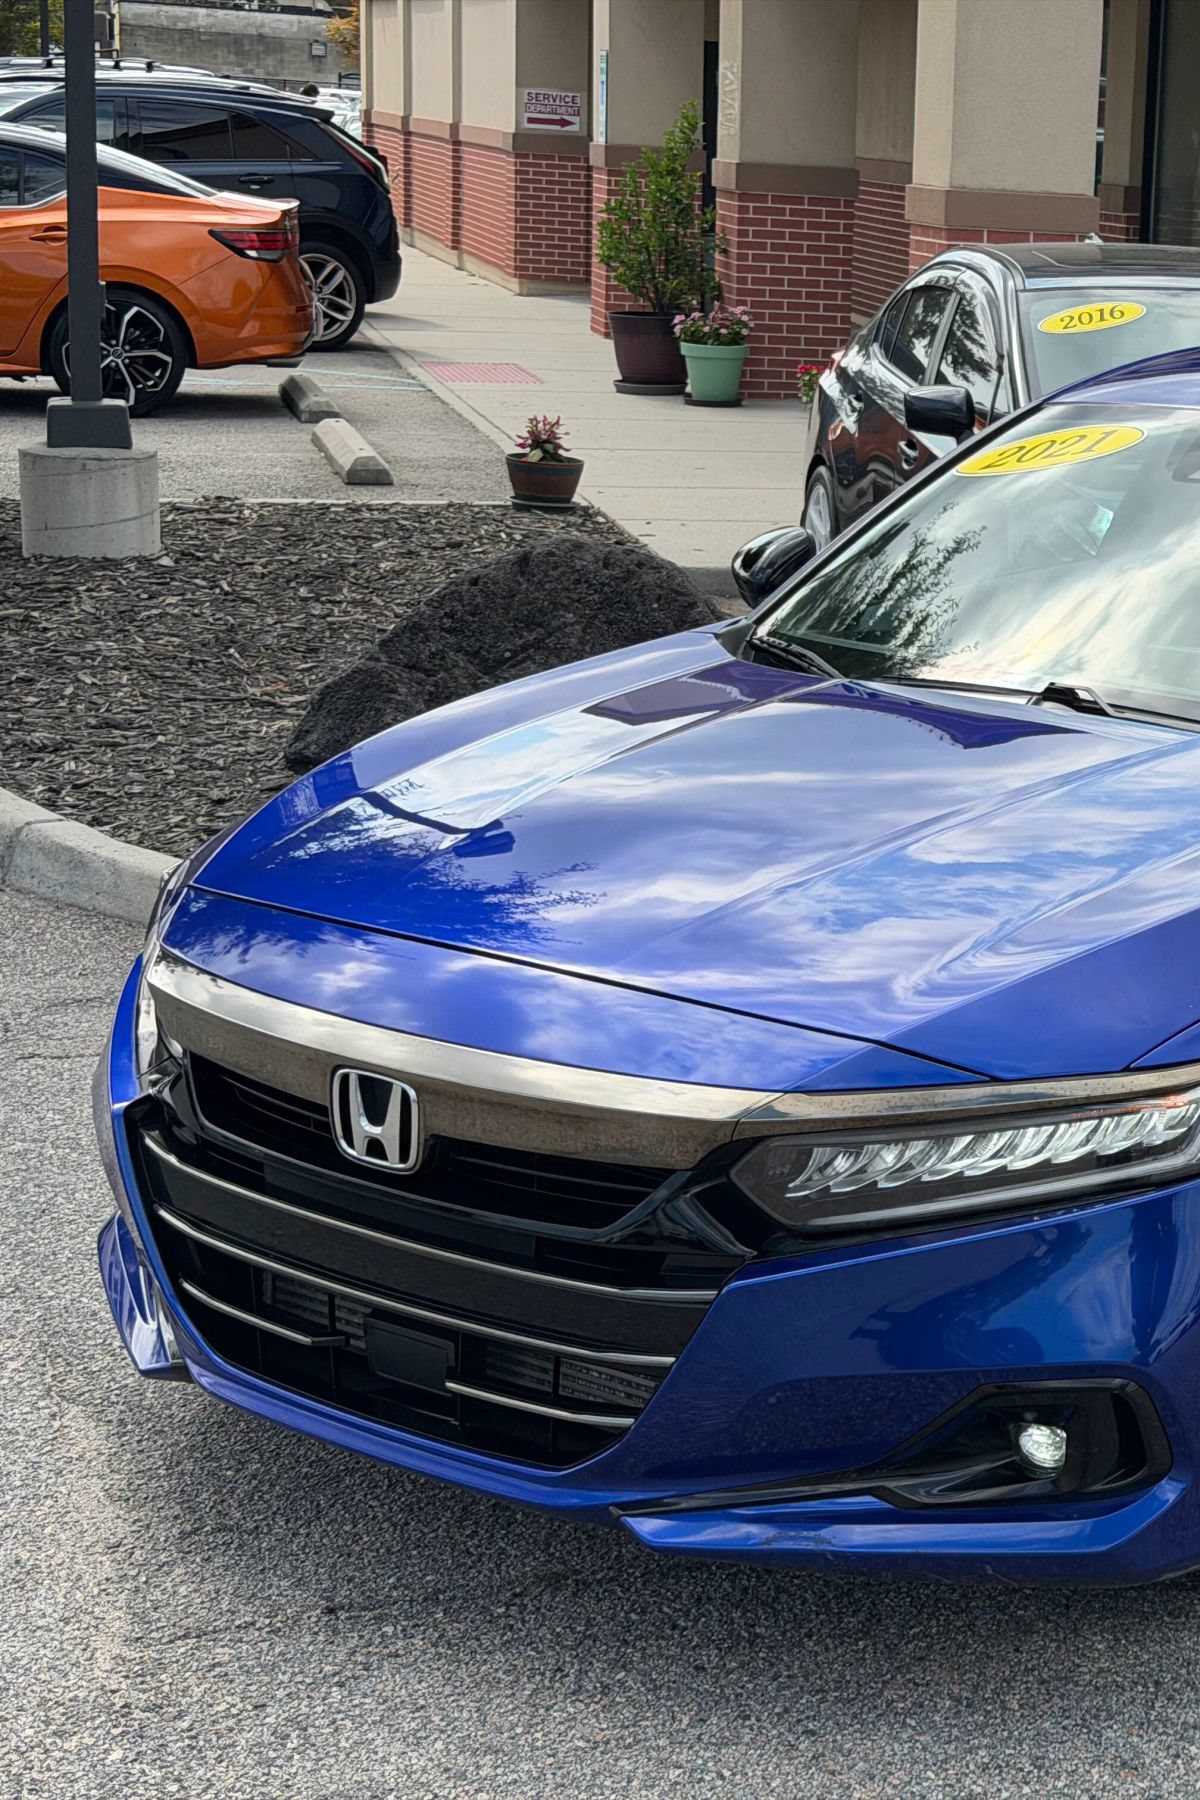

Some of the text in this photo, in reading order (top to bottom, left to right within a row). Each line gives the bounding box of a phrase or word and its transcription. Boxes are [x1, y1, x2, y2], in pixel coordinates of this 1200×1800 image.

[527, 92, 579, 105] SERVICE
[526, 104, 579, 115] DEPARTMENT
[1059, 304, 1125, 330] 2016
[978, 429, 1120, 471] 2021
